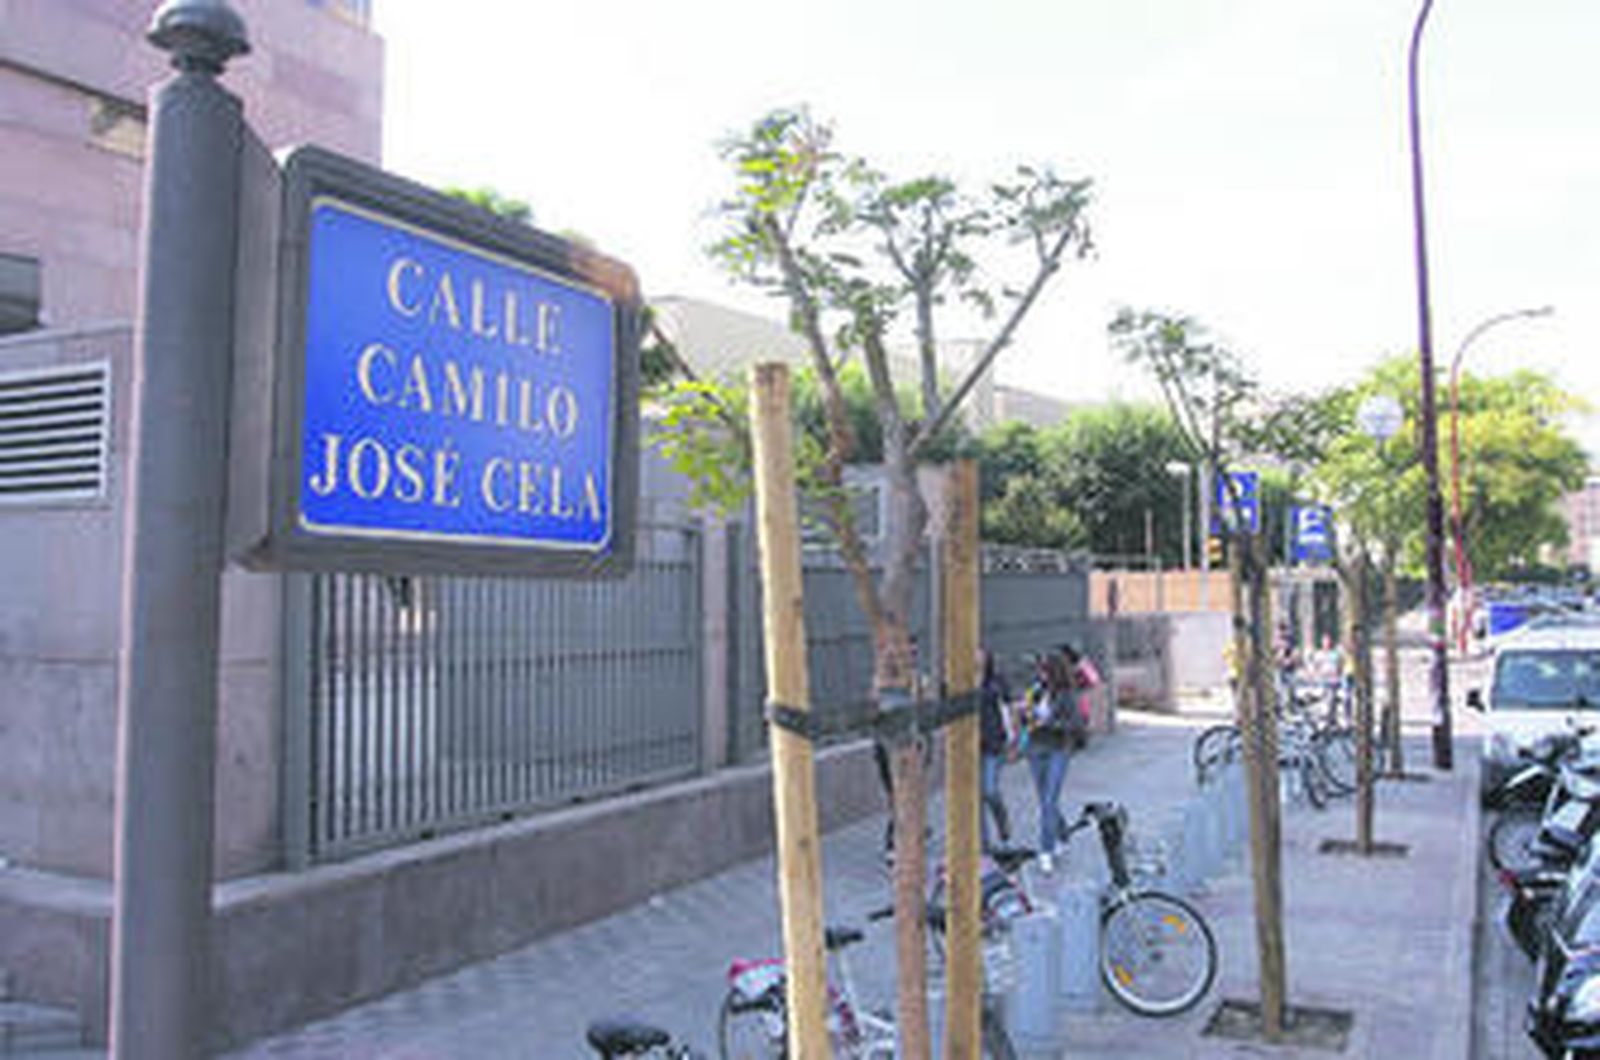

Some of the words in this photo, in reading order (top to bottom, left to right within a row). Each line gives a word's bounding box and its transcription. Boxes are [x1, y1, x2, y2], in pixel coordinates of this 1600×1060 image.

[387, 257, 562, 355] CALLE
[357, 343, 578, 438] CAMILO
[309, 433, 461, 507] JOSÉ
[481, 457, 600, 523] CELA
